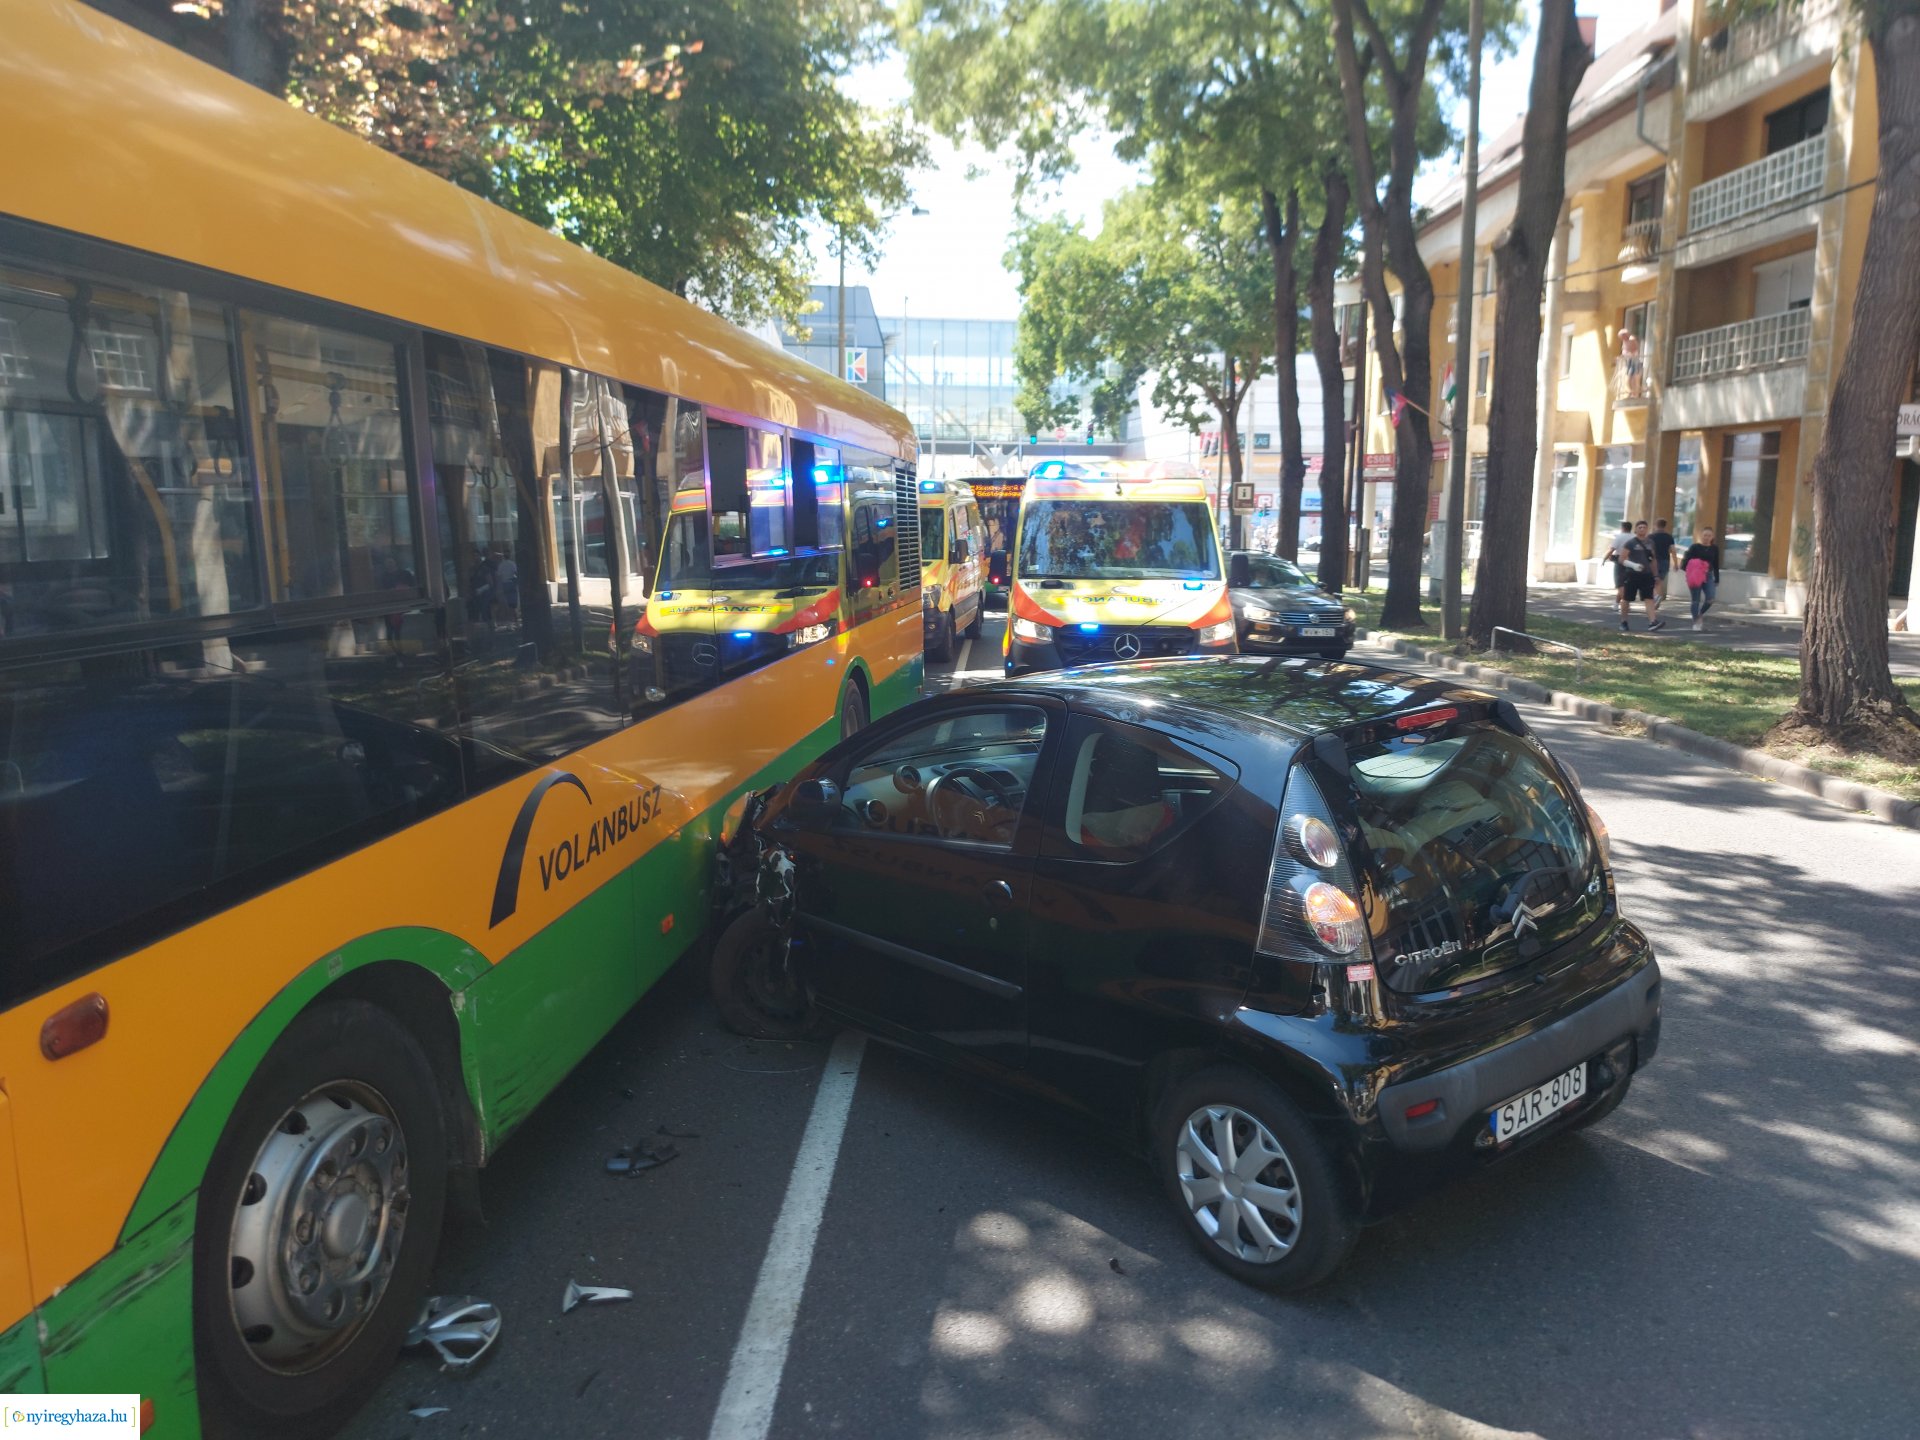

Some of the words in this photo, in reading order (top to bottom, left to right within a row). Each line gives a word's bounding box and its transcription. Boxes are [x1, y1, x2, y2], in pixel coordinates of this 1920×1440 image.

[539, 784, 662, 892] VOLÁNBUSZ
[1394, 940, 1462, 966] CITROËN
[1502, 1065, 1582, 1135] SAR-808
